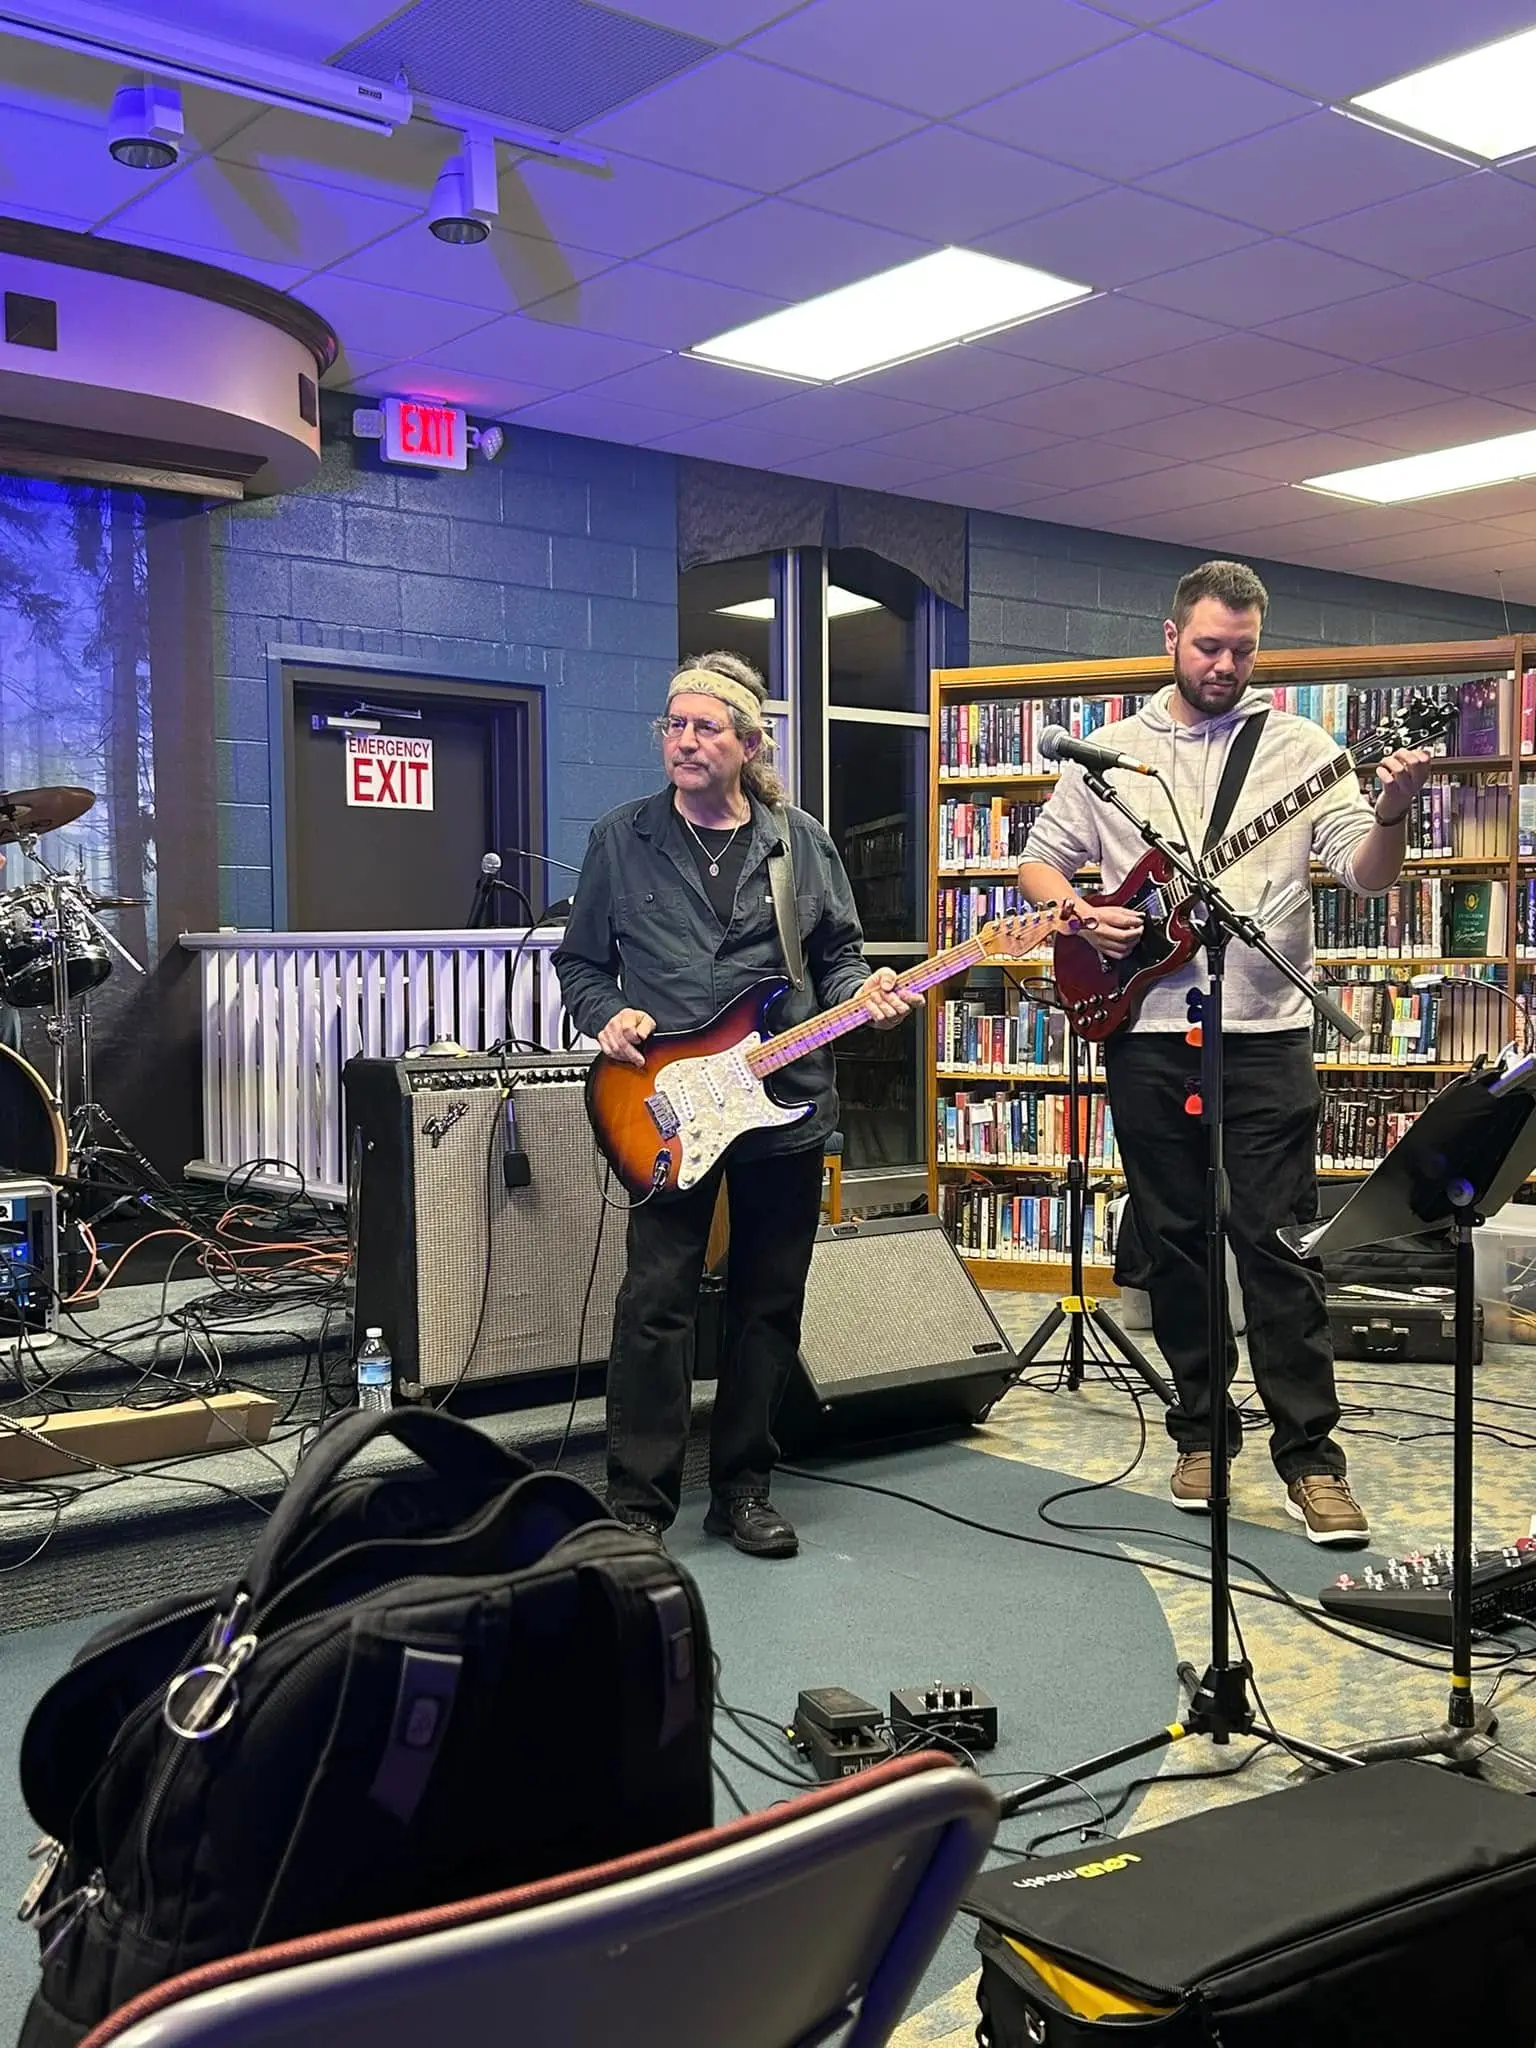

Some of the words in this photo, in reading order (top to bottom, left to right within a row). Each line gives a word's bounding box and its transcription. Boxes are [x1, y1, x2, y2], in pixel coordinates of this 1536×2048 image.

[399, 402, 457, 459] EXIT
[348, 736, 430, 759] EMERGENCY
[353, 757, 429, 804] EXIT
